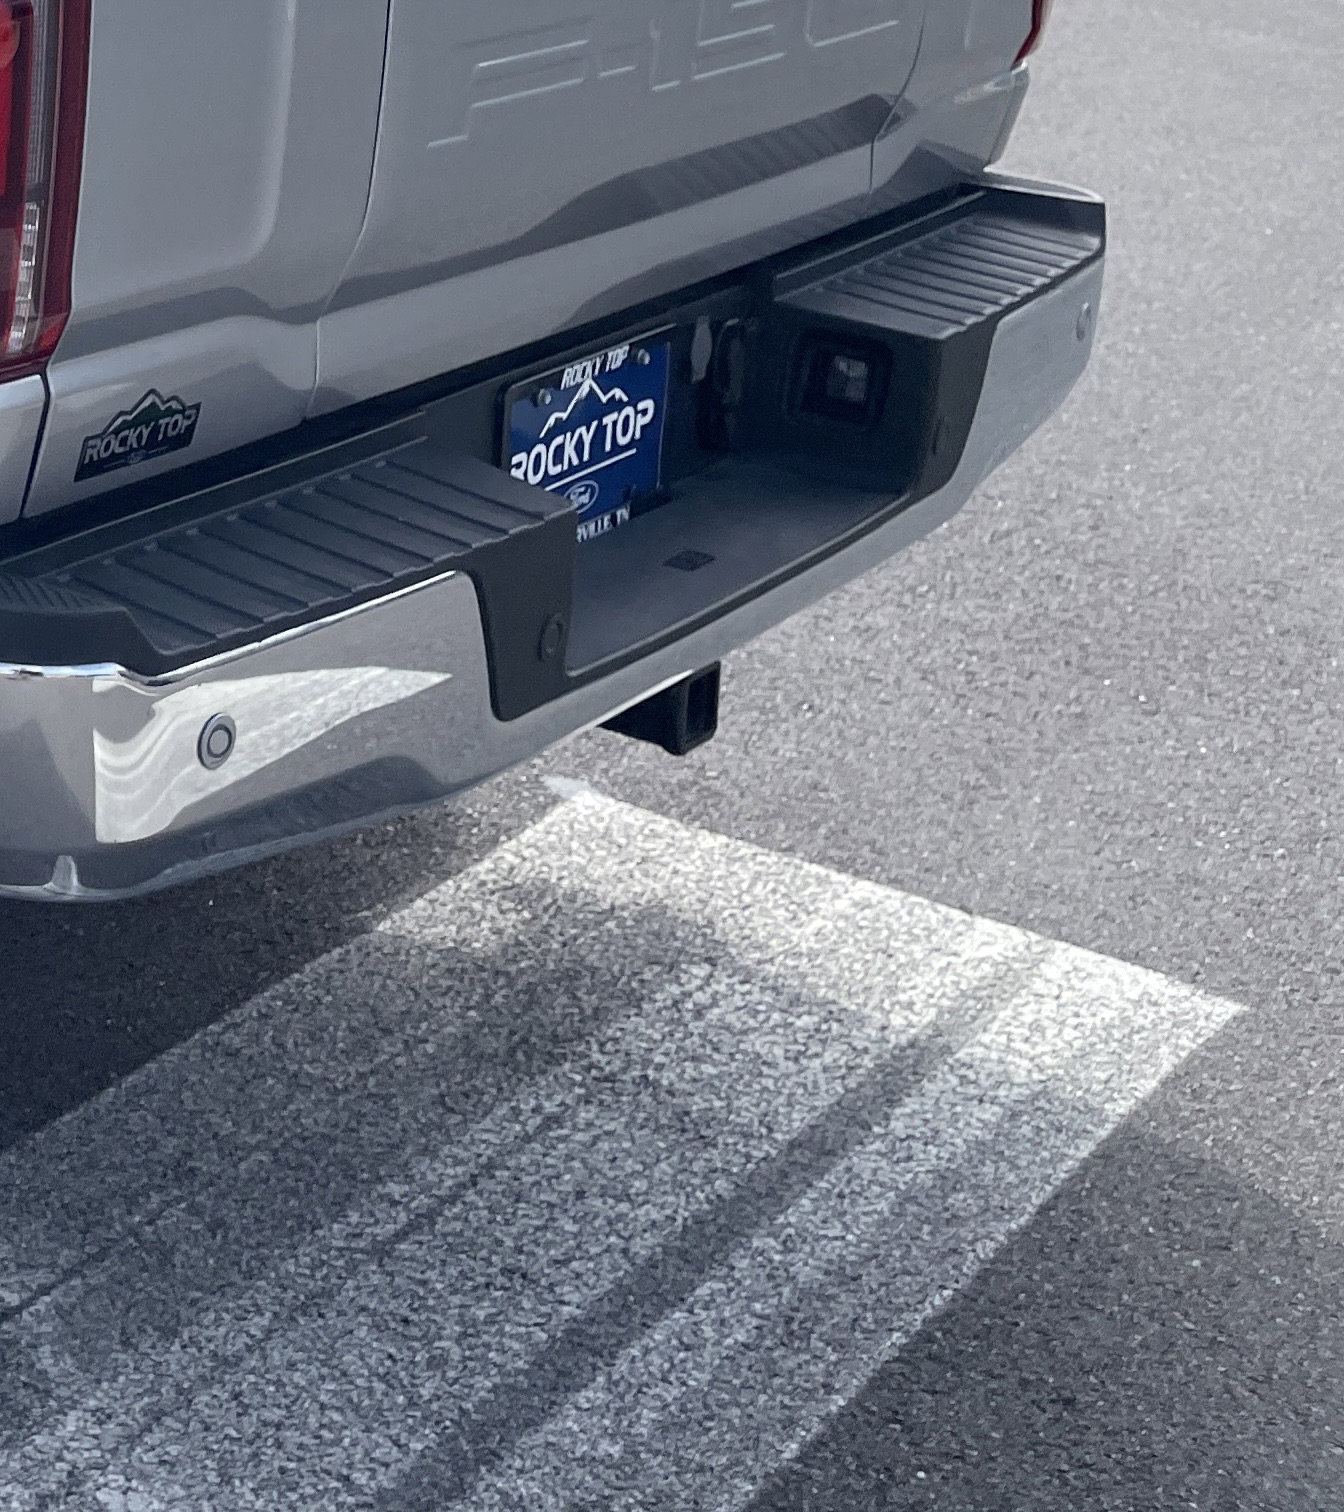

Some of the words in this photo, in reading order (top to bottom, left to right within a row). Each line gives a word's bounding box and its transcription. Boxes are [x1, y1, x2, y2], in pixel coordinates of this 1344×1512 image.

[561, 353, 604, 390] ROCKY
[605, 345, 630, 372] TOP
[84, 421, 155, 464] ROCKY
[158, 409, 197, 441] TOP
[510, 420, 598, 485] ROCKY
[602, 398, 655, 452] TOP
